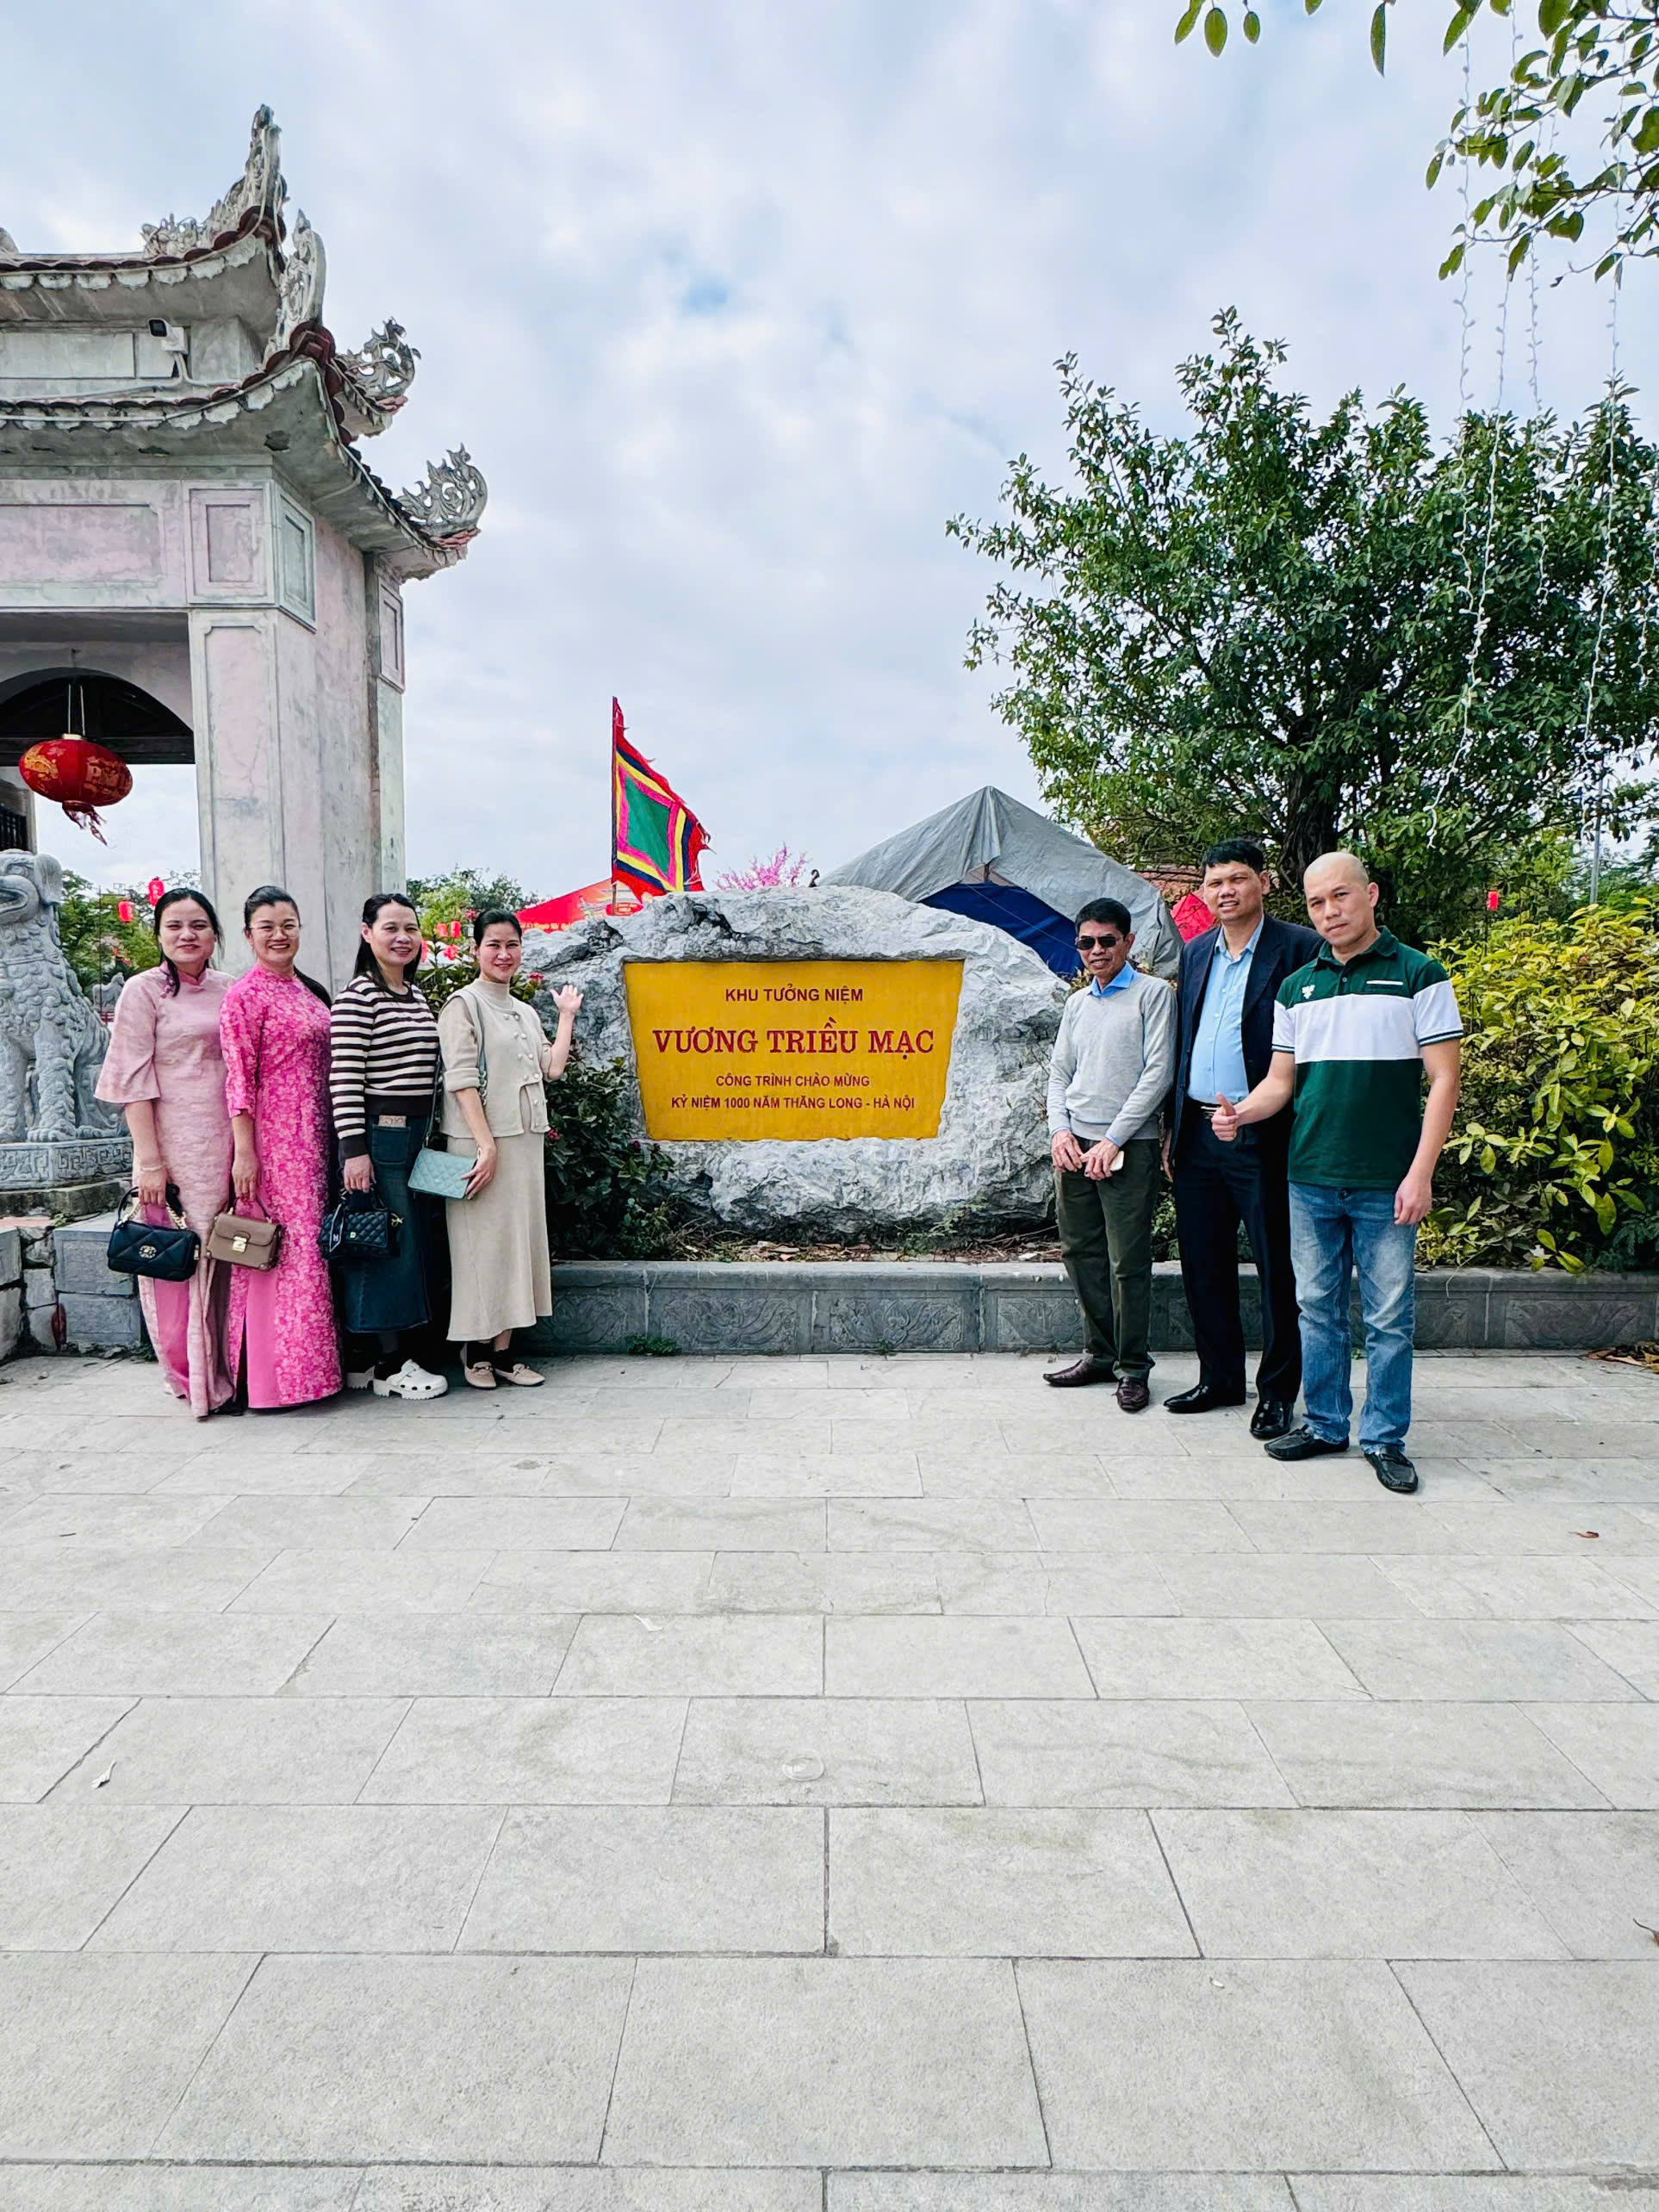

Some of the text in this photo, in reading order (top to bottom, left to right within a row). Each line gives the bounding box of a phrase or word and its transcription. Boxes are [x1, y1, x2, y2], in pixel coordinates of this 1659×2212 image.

[725, 984, 863, 1005] KHU TƯỞNG NIỆM
[652, 1016, 934, 1060] VƯƠNG TRIỀU MẠC
[716, 1072, 870, 1087] CÔNG TRÌNH CHÀO MỪNG
[671, 1094, 687, 1109] KỶ
[691, 1095, 720, 1111] NIỆM
[724, 1097, 750, 1109] 1000
[754, 1095, 780, 1109] NĂM
[783, 1095, 825, 1109] THĂNG
[829, 1097, 862, 1109] LONG
[873, 1094, 890, 1109] HÀ
[894, 1094, 915, 1112] NỘI
